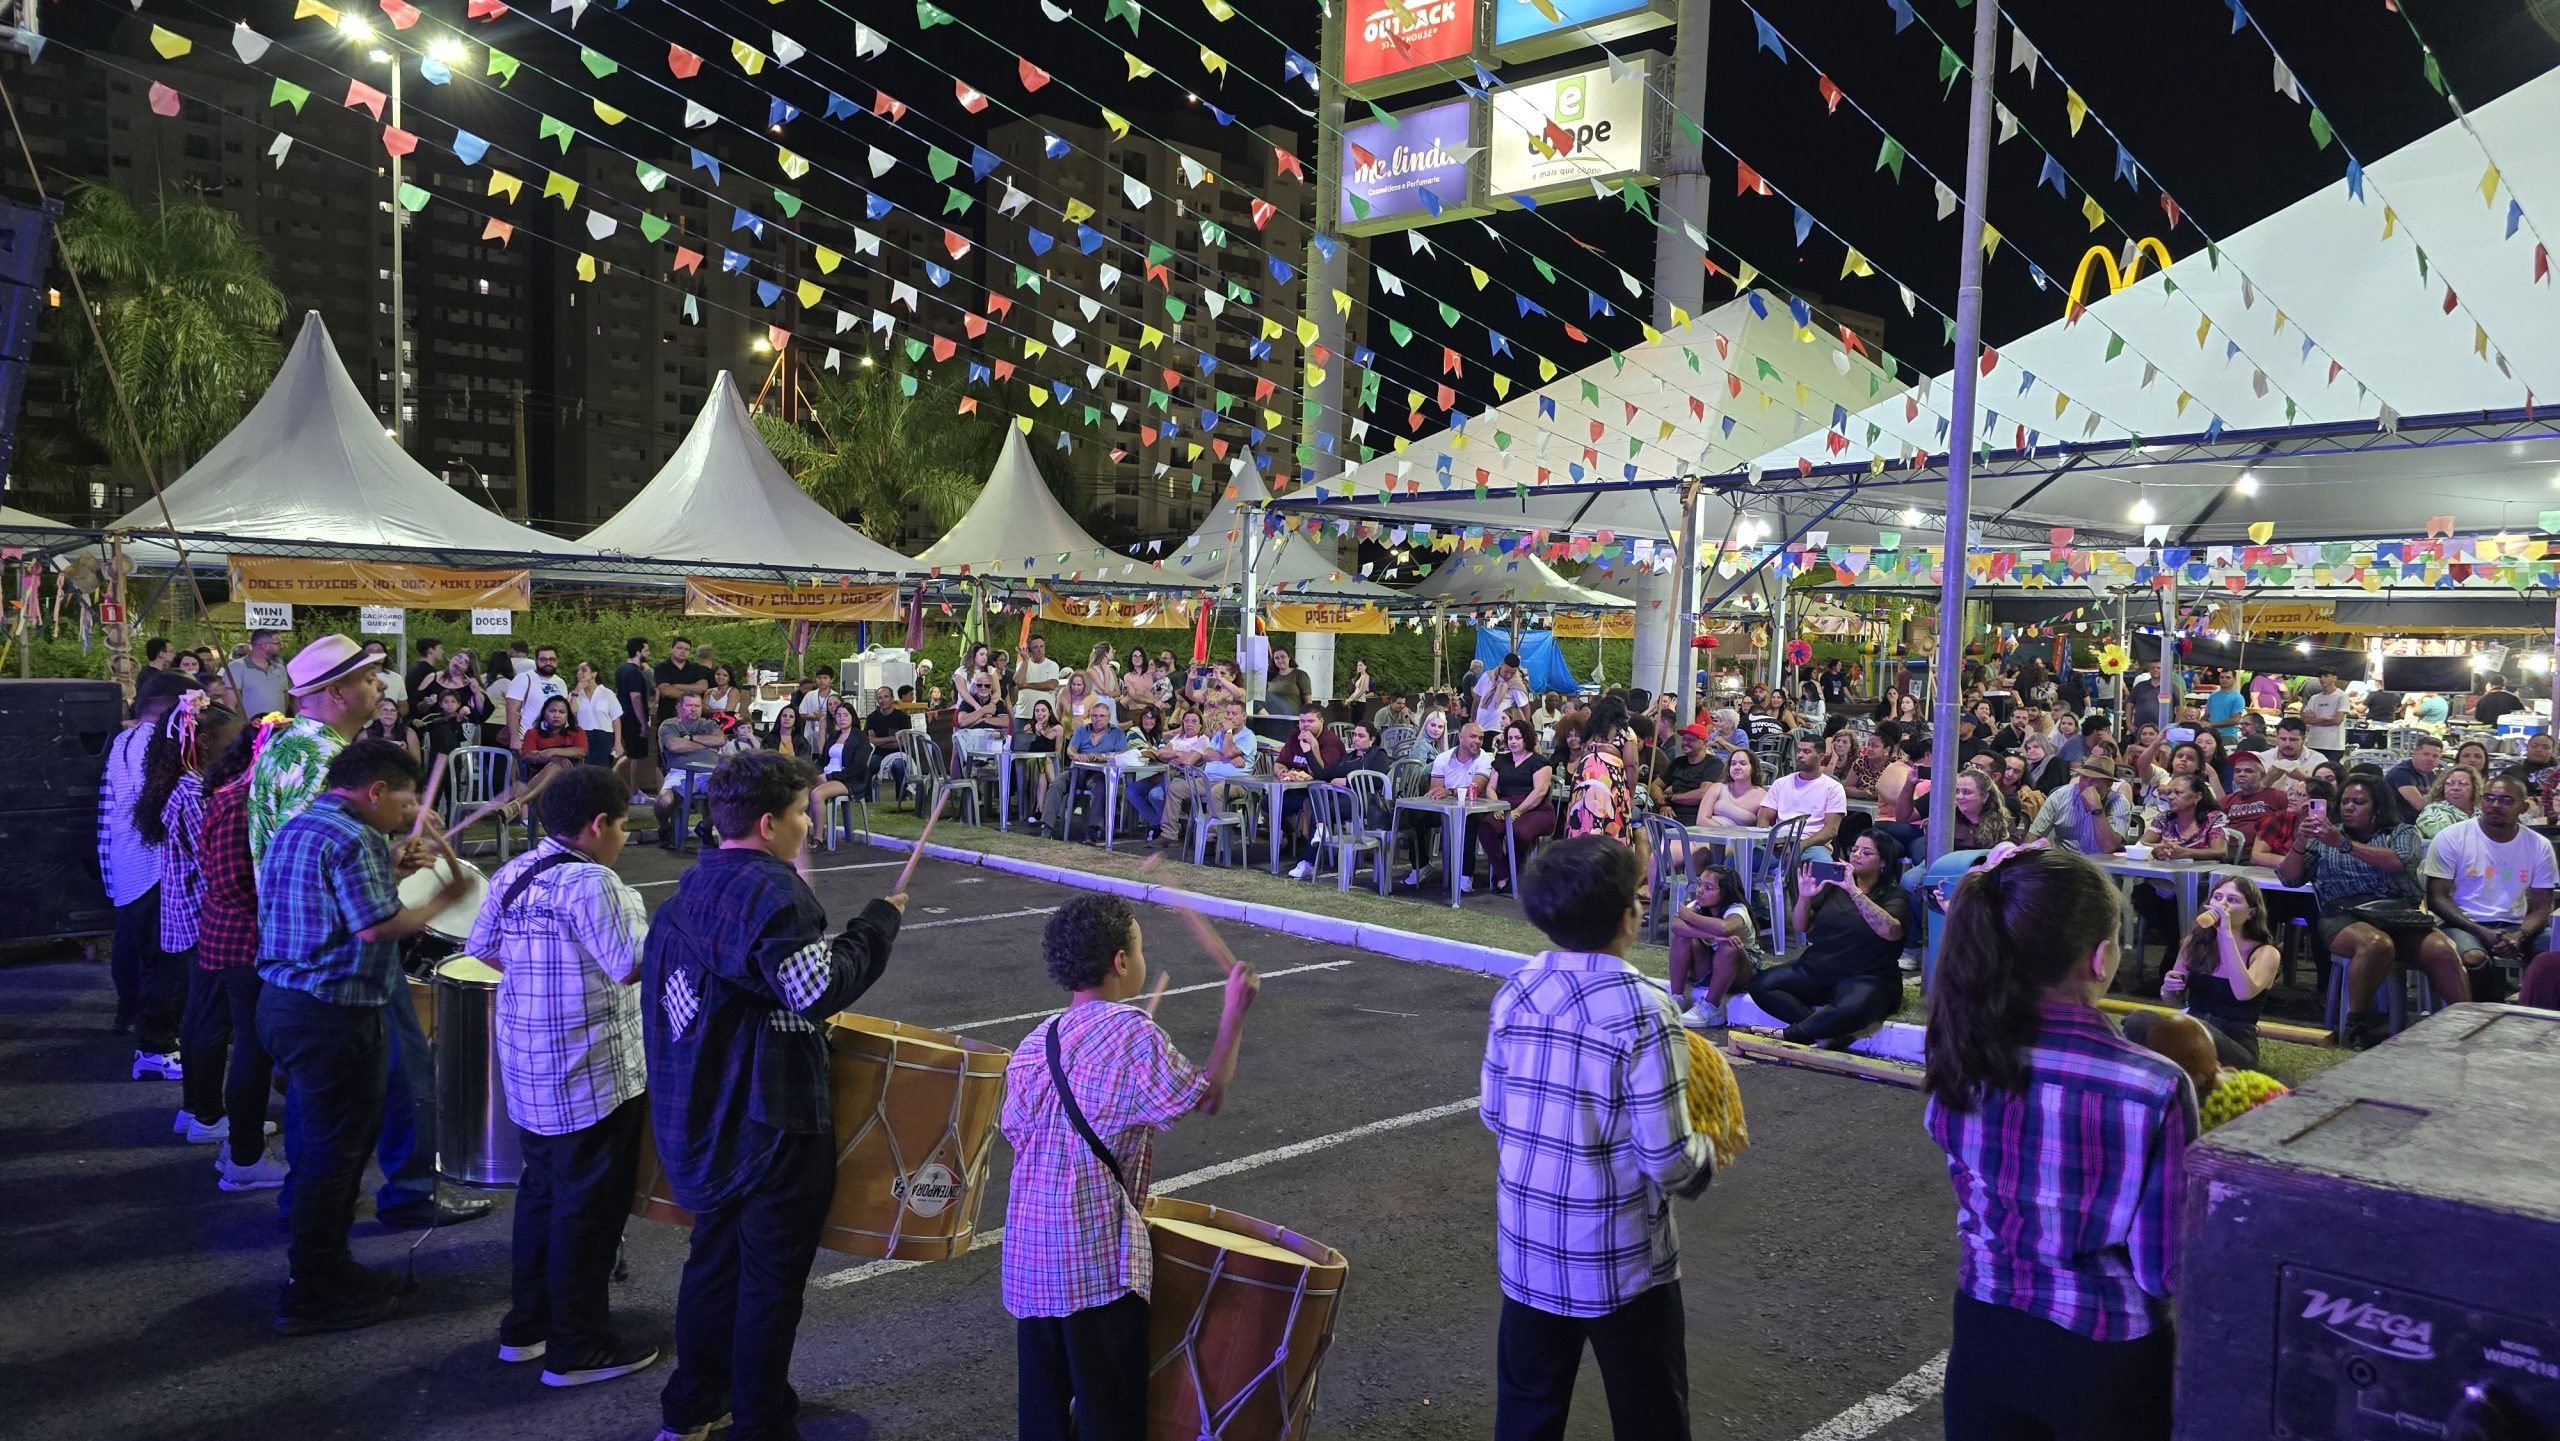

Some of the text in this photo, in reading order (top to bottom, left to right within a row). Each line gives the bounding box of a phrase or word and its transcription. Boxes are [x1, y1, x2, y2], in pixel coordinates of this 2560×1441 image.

[1364, 1, 1456, 42] OUTACK
[1540, 168, 1557, 179] mais
[1560, 168, 1575, 176] que
[1368, 183, 1401, 197] Cosméticos
[1406, 176, 1440, 189] Perfumaria
[249, 579, 293, 589] DOCES
[298, 574, 358, 589] TÍPICOS
[440, 579, 471, 589] MINI
[771, 593, 824, 606] CALDOS
[253, 607, 283, 616] MINI
[1305, 610, 1351, 624] PASTEL
[250, 618, 289, 627] PIZZA
[475, 617, 509, 626] DOCES
[2265, 613, 2301, 624] PIZZA
[2302, 1289, 2432, 1343] WEGA
